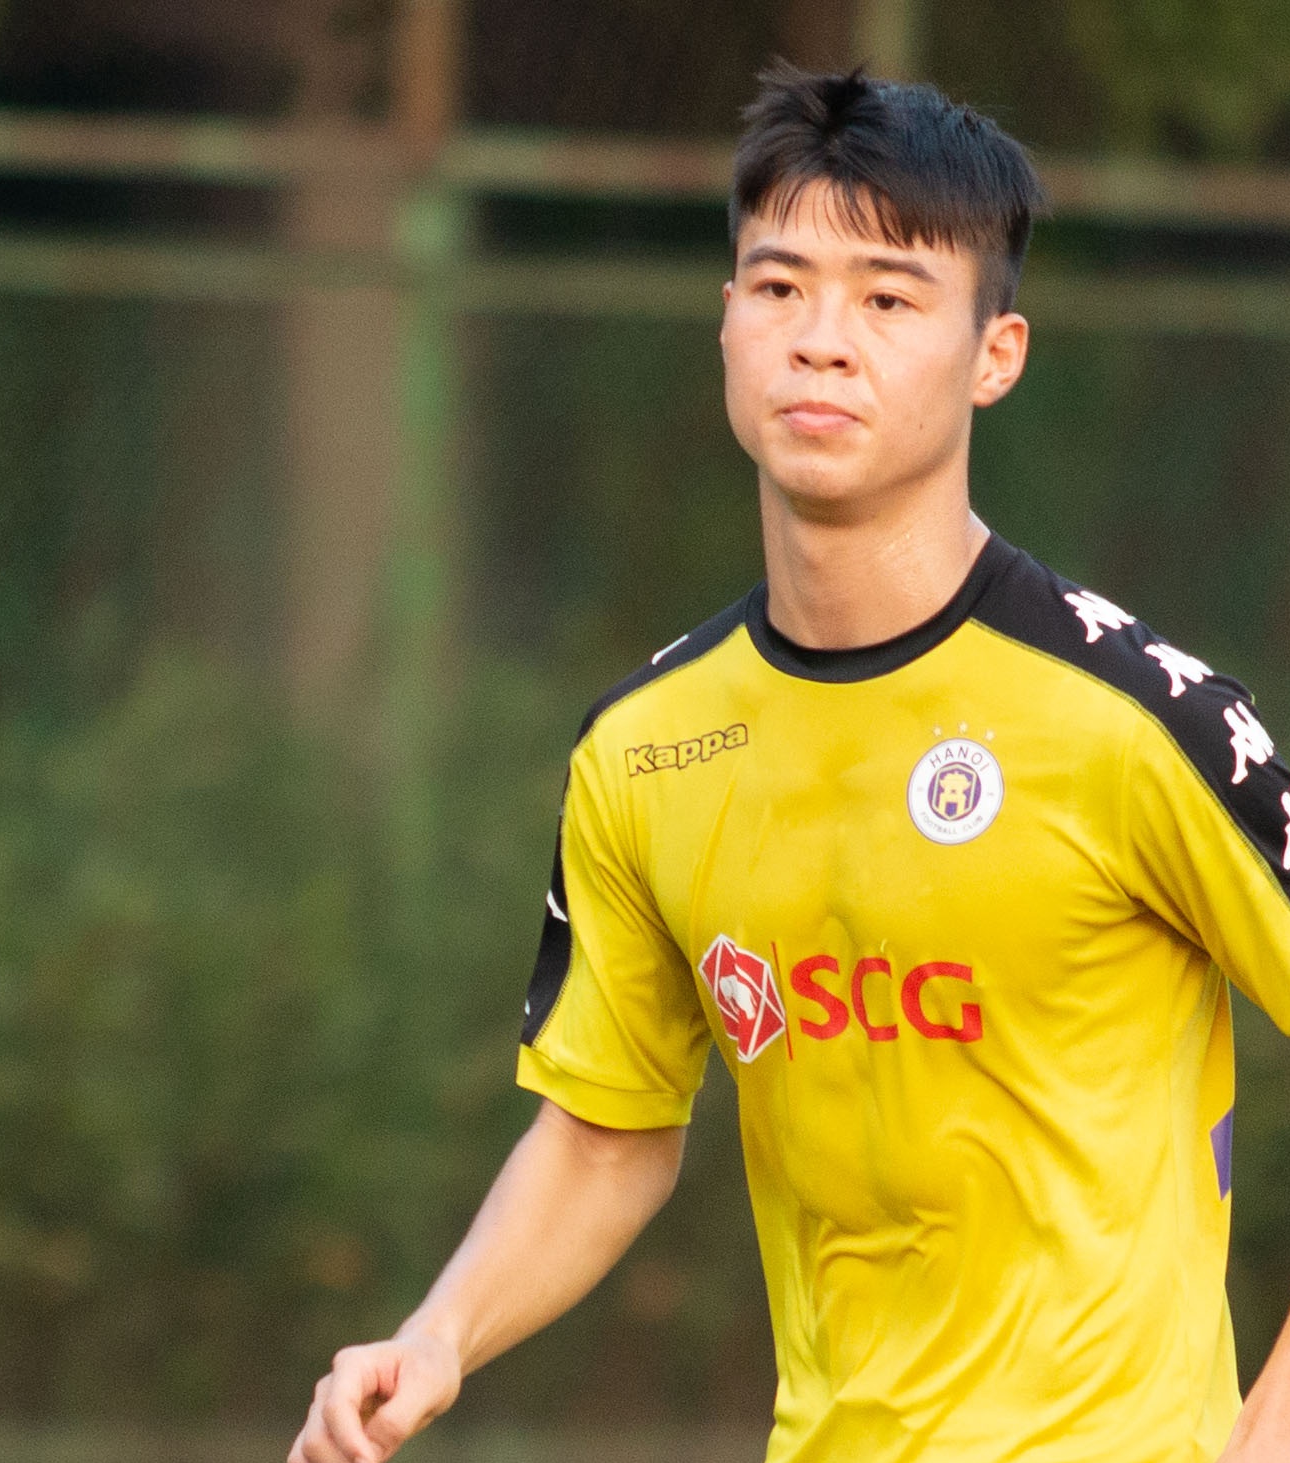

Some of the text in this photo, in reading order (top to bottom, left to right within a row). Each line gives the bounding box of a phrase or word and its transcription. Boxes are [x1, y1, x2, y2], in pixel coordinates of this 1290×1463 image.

[625, 723, 748, 777] Kappa
[930, 747, 989, 771] HANOI
[790, 954, 983, 1043] SCG
